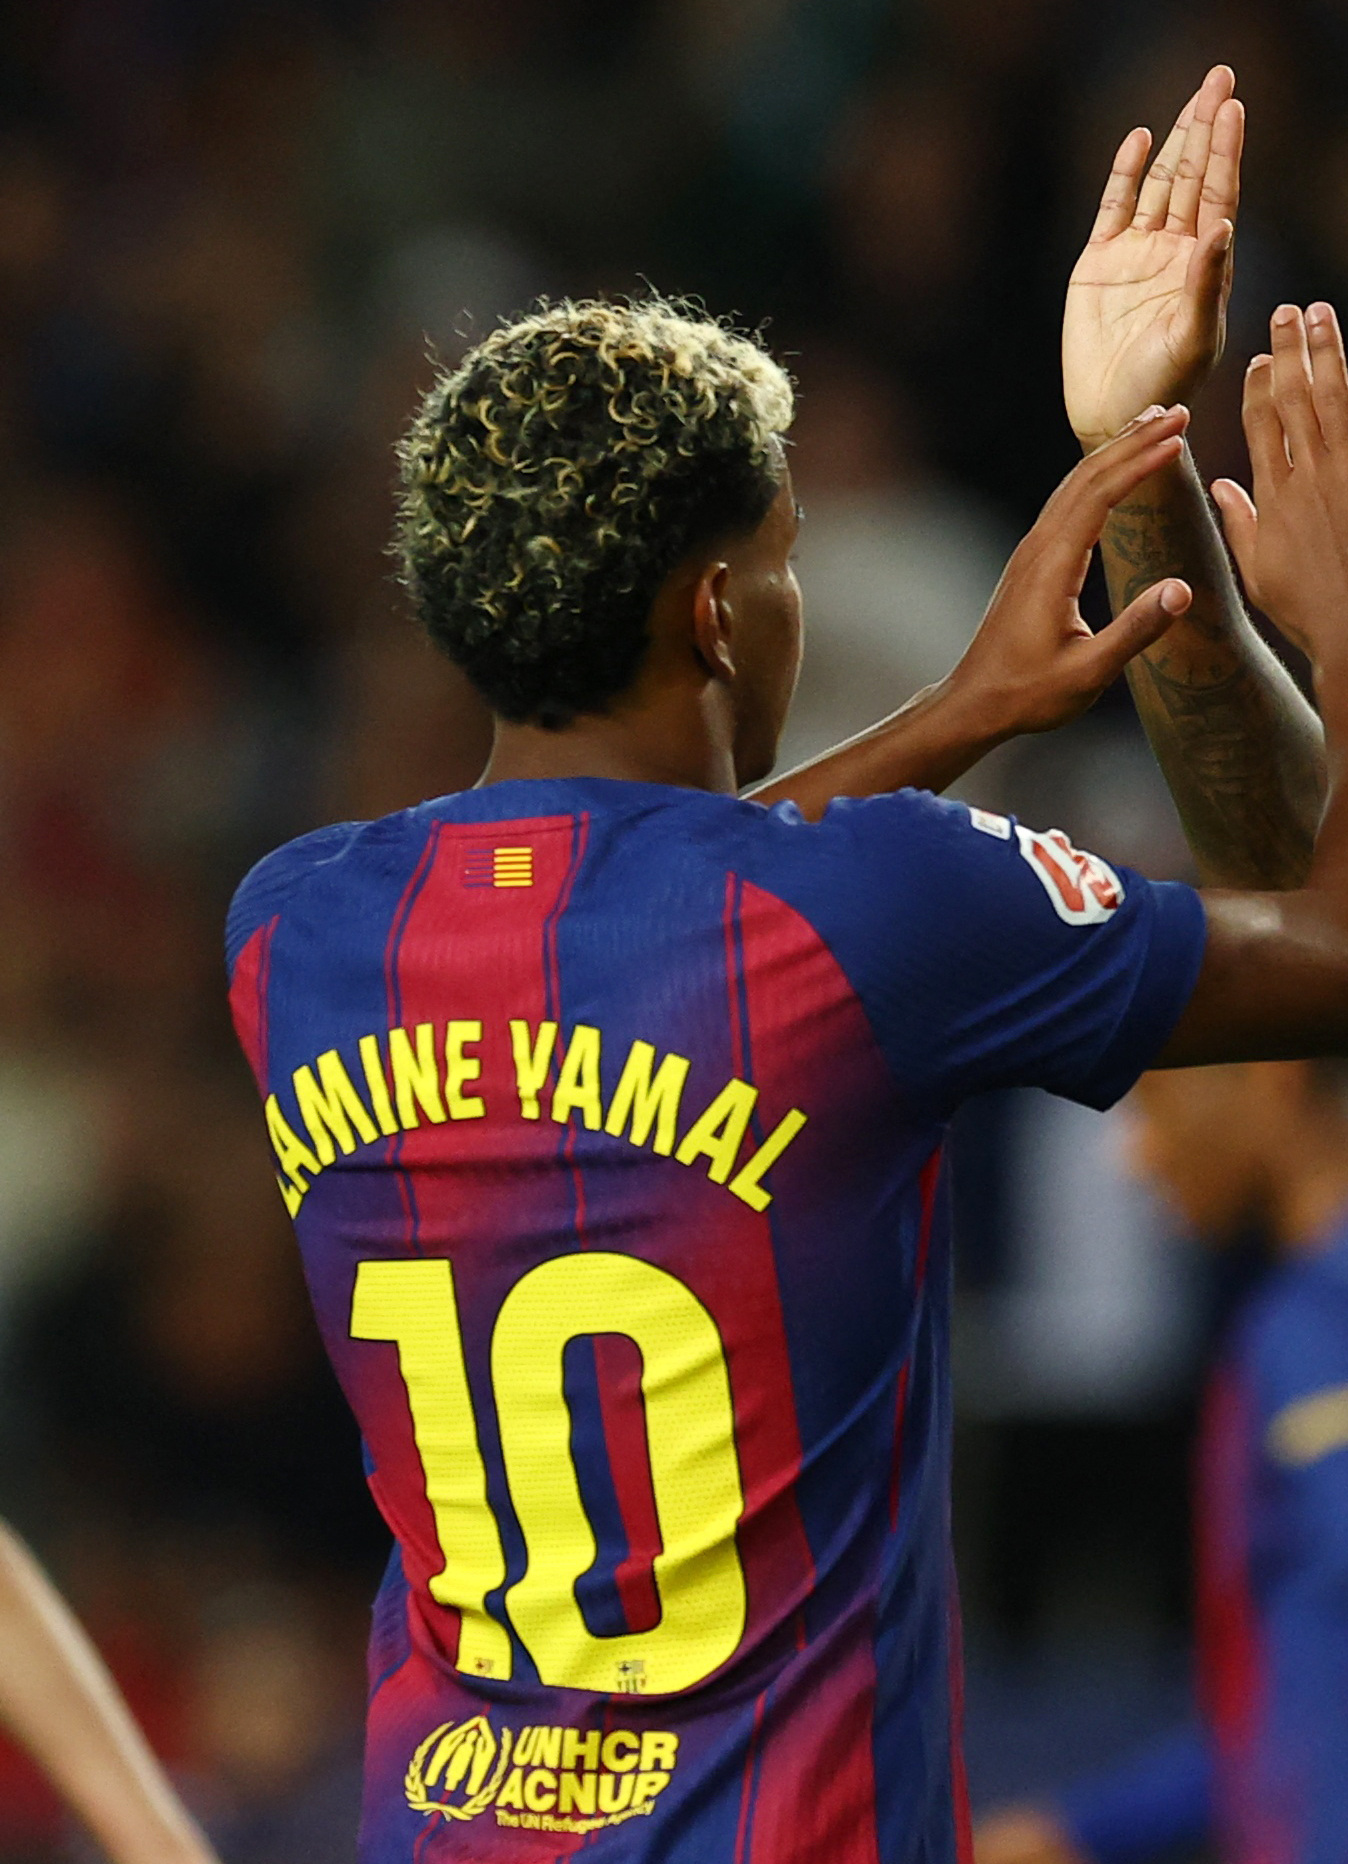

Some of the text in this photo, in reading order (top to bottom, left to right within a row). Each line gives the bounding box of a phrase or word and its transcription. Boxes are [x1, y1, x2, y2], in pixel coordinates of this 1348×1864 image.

[509, 1020, 807, 1212] YAMAL
[349, 1251, 746, 1695] 10
[512, 1725, 679, 1773] UNHCR
